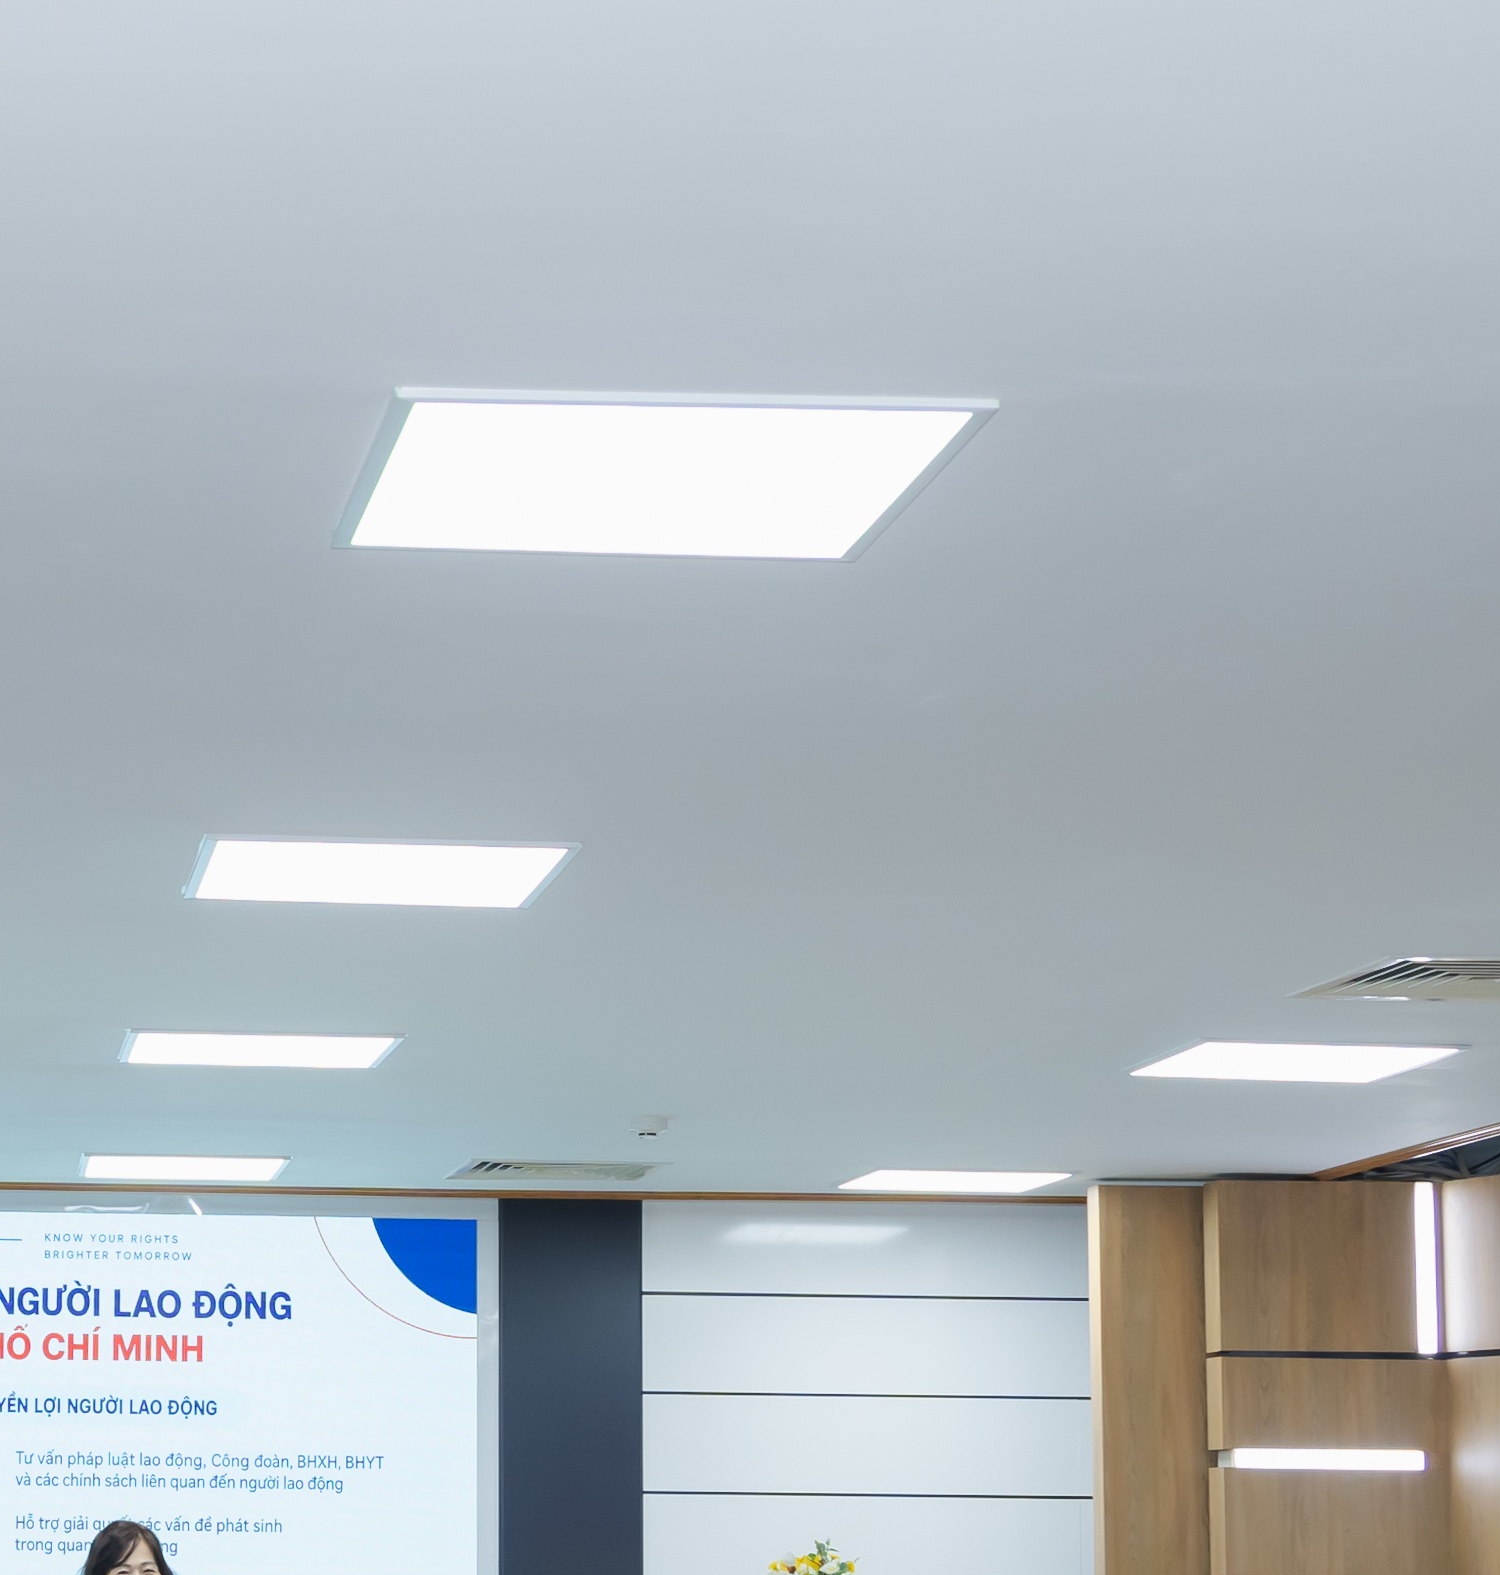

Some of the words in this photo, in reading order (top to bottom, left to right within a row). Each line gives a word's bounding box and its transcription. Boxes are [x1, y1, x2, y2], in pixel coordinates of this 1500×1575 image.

[44, 1233, 84, 1243] KNOW
[90, 1233, 124, 1243] YOUR
[131, 1234, 178, 1244] RIGHTS
[44, 1250, 109, 1260] BRIGHTER
[116, 1251, 192, 1261] TOMORROW
[114, 1289, 181, 1318] LAO
[192, 1283, 292, 1327] ĐỘNG
[42, 1326, 101, 1361] CHÍ
[112, 1334, 203, 1362] MINH
[34, 1397, 61, 1417] LỢI
[67, 1395, 123, 1415] NGƯỜI
[129, 1399, 162, 1415] LAO
[168, 1396, 217, 1419] ĐỘNG
[16, 1451, 34, 1465] Tư
[38, 1449, 63, 1466] vấn
[67, 1452, 103, 1470] pháp
[107, 1451, 135, 1469] luật
[139, 1452, 160, 1467] lao
[164, 1452, 207, 1472] động,
[211, 1452, 249, 1471] Công
[254, 1454, 293, 1471] đoàn,
[297, 1455, 341, 1471] BHXH,
[345, 1456, 383, 1470] BHYT
[16, 1473, 31, 1487] và
[35, 1473, 59, 1487] các
[63, 1472, 101, 1488] chính
[105, 1473, 137, 1488] sách
[141, 1474, 166, 1489] liên
[170, 1477, 205, 1492] quan
[209, 1473, 236, 1490] đến
[239, 1475, 279, 1492] người
[283, 1476, 304, 1491] lao
[307, 1476, 344, 1494] động
[15, 1513, 34, 1530] Hỗ
[39, 1518, 59, 1533] trợ
[64, 1516, 88, 1533] giải
[165, 1515, 190, 1532] vấn
[194, 1514, 213, 1533] đề
[216, 1518, 249, 1536] phát
[253, 1518, 282, 1533] sinh
[15, 1539, 52, 1554] trong
